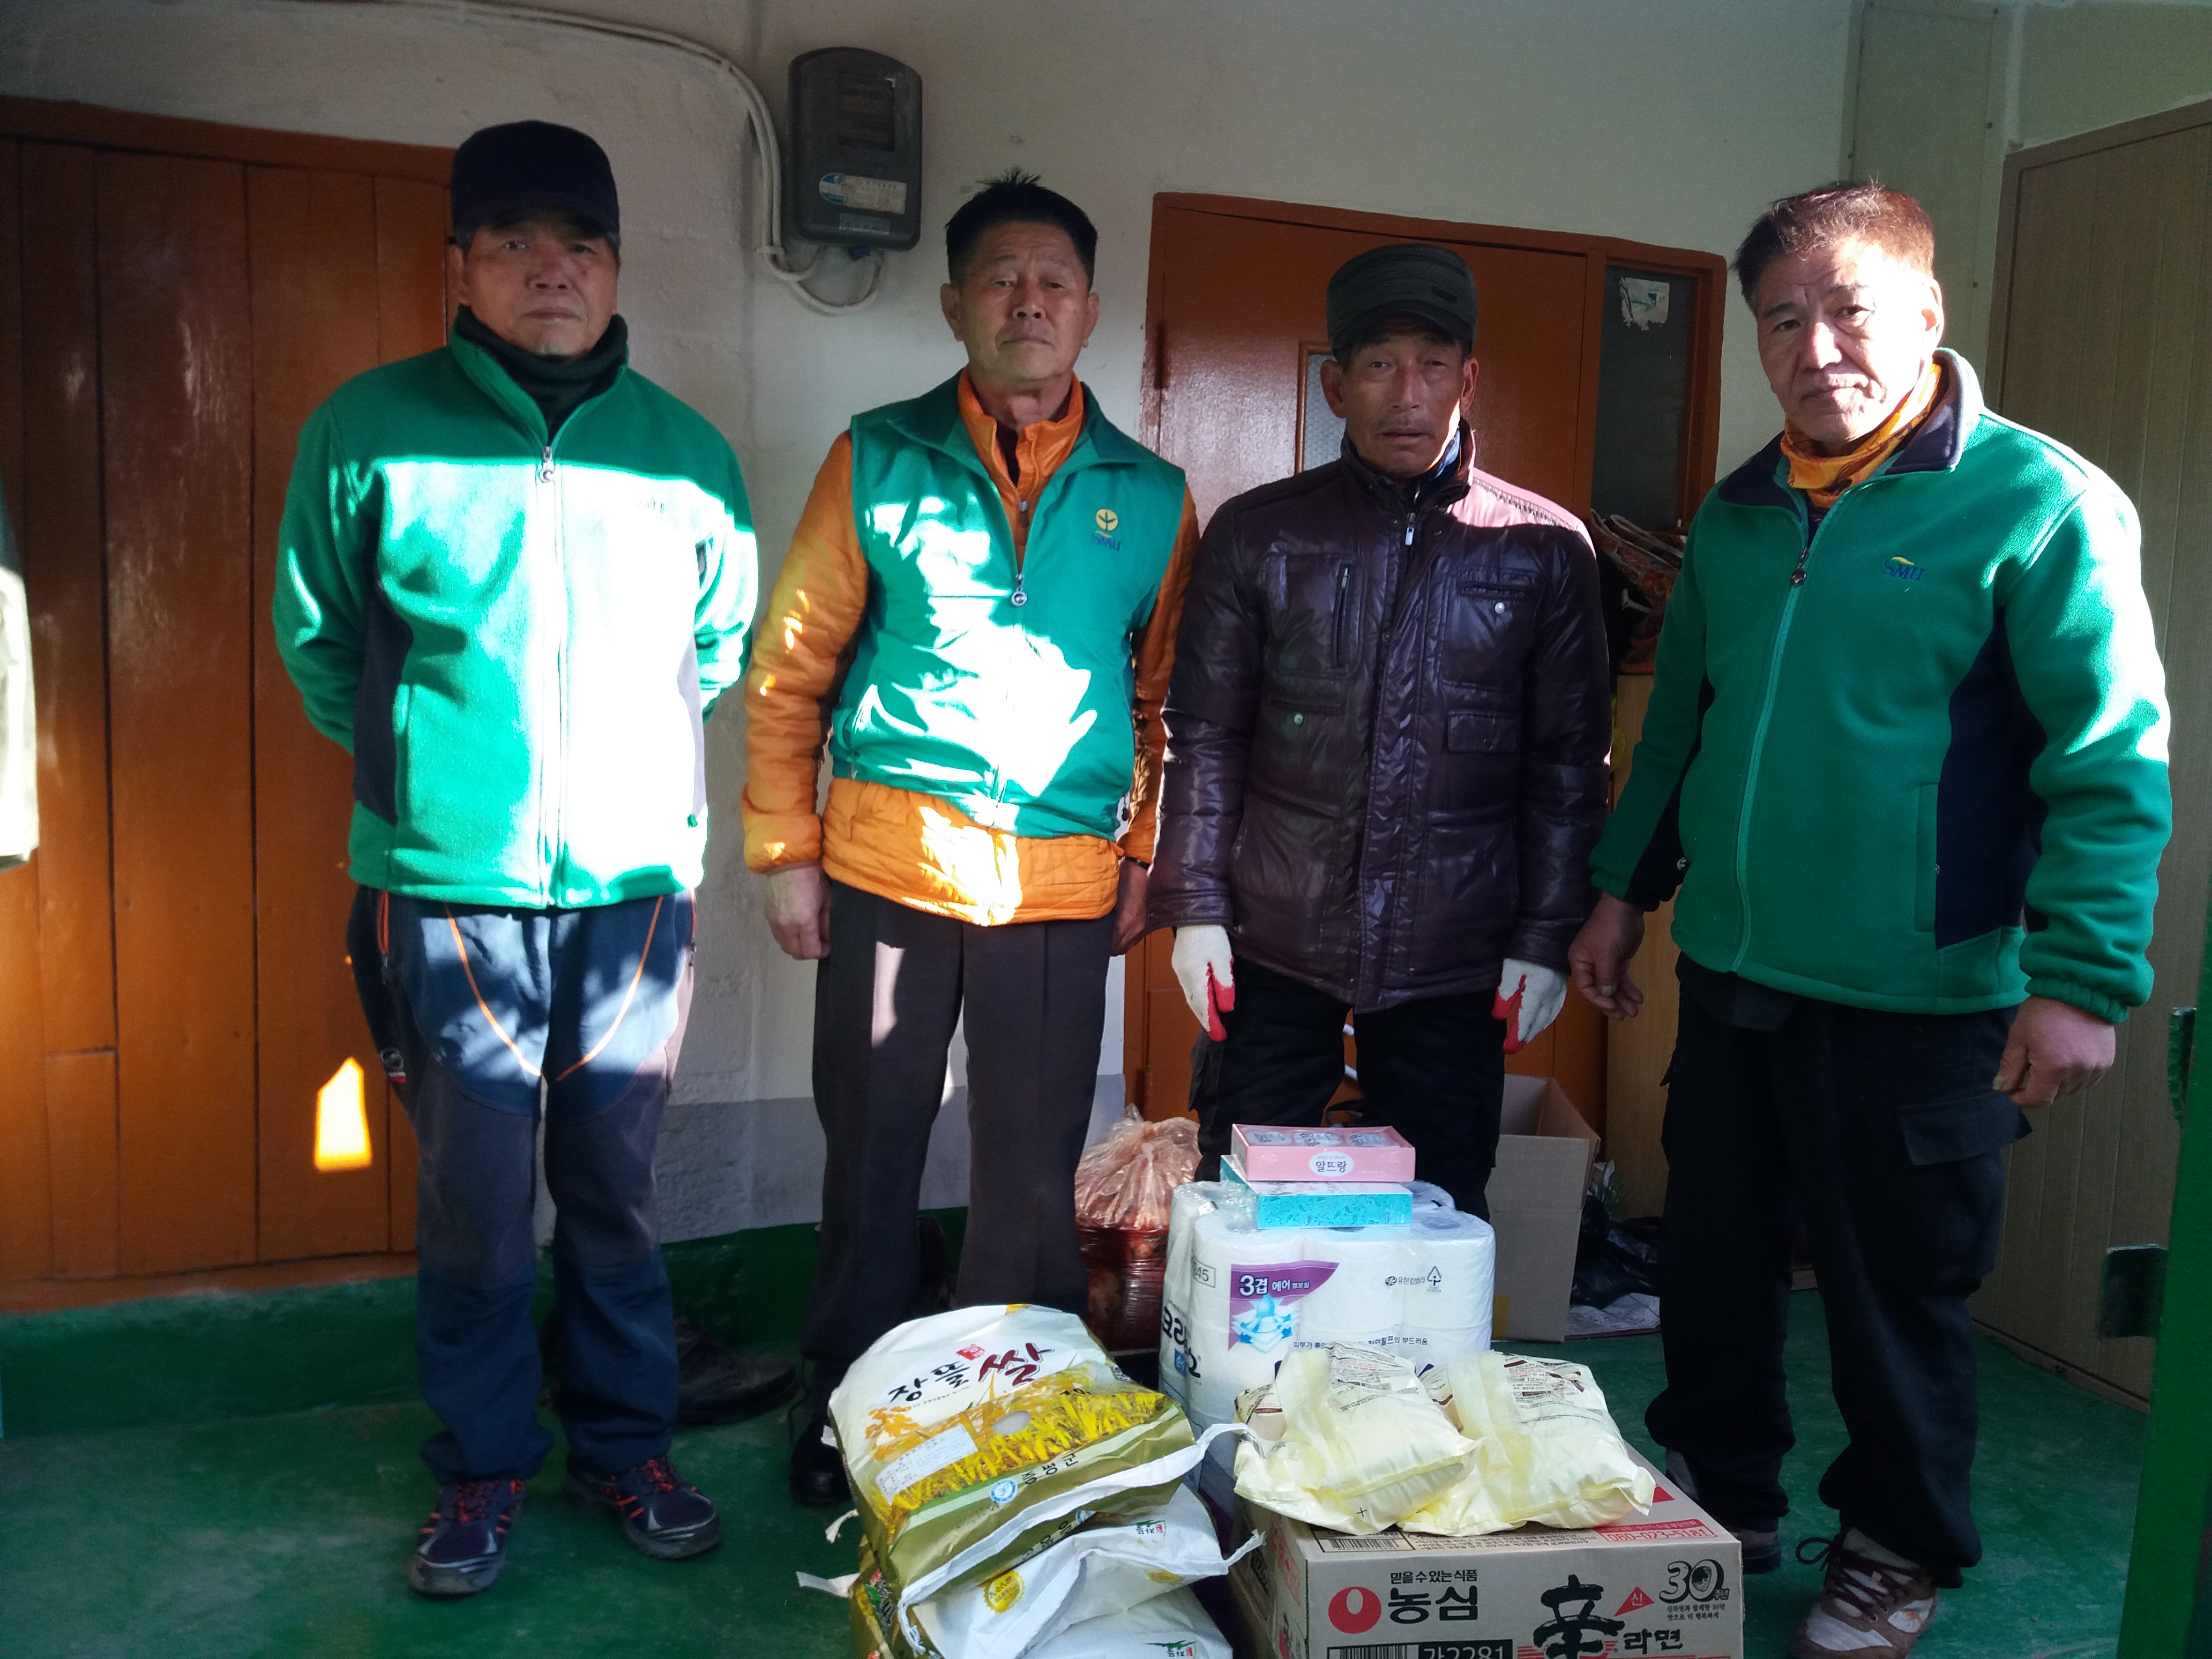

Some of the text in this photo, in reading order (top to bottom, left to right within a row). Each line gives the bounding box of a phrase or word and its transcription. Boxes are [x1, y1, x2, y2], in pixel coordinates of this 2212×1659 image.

[1881, 558, 1924, 581] SMU
[1316, 1161, 1347, 1173] 알뜨랑
[1239, 1274, 1268, 1296] 3겹
[1272, 1279, 1291, 1292] 에어
[1402, 1337, 1428, 1346] 부드러움
[1391, 1569, 1477, 1585] 믿을 수 있는 식품
[1388, 1585, 1478, 1624] 농심
[1631, 1592, 1643, 1607] 신
[1623, 1628, 1683, 1655] 라면
